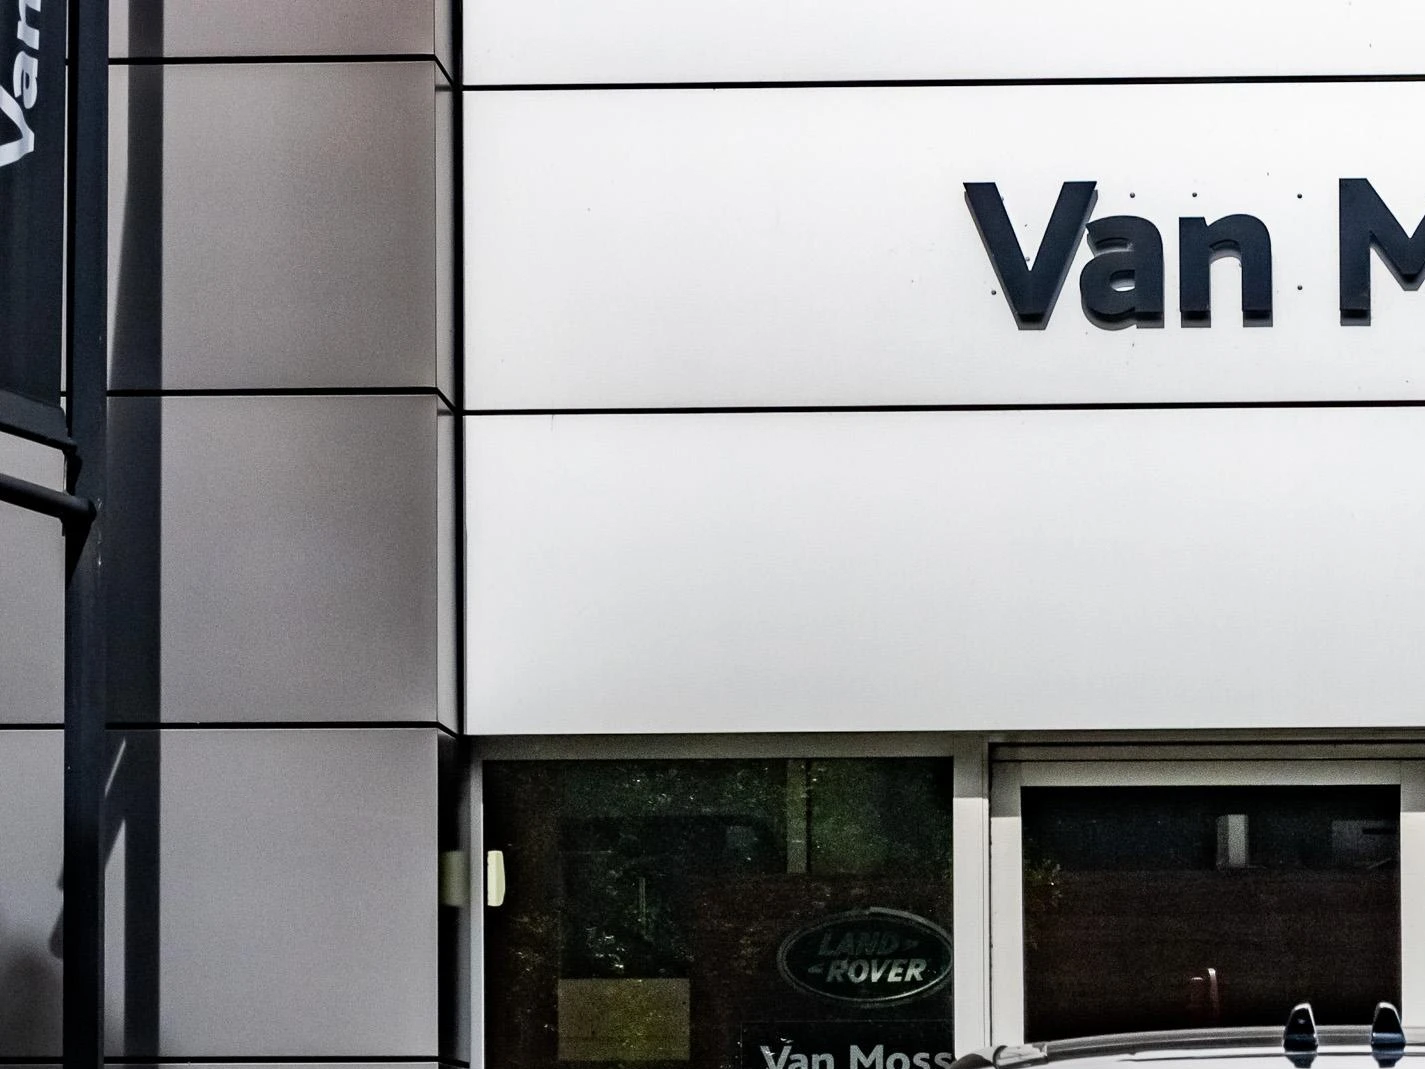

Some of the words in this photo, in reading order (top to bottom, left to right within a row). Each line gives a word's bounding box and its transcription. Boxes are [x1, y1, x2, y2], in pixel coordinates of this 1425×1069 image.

[963, 180, 1273, 328] Van
[819, 932, 899, 956] LAND
[826, 958, 928, 984] ROVER
